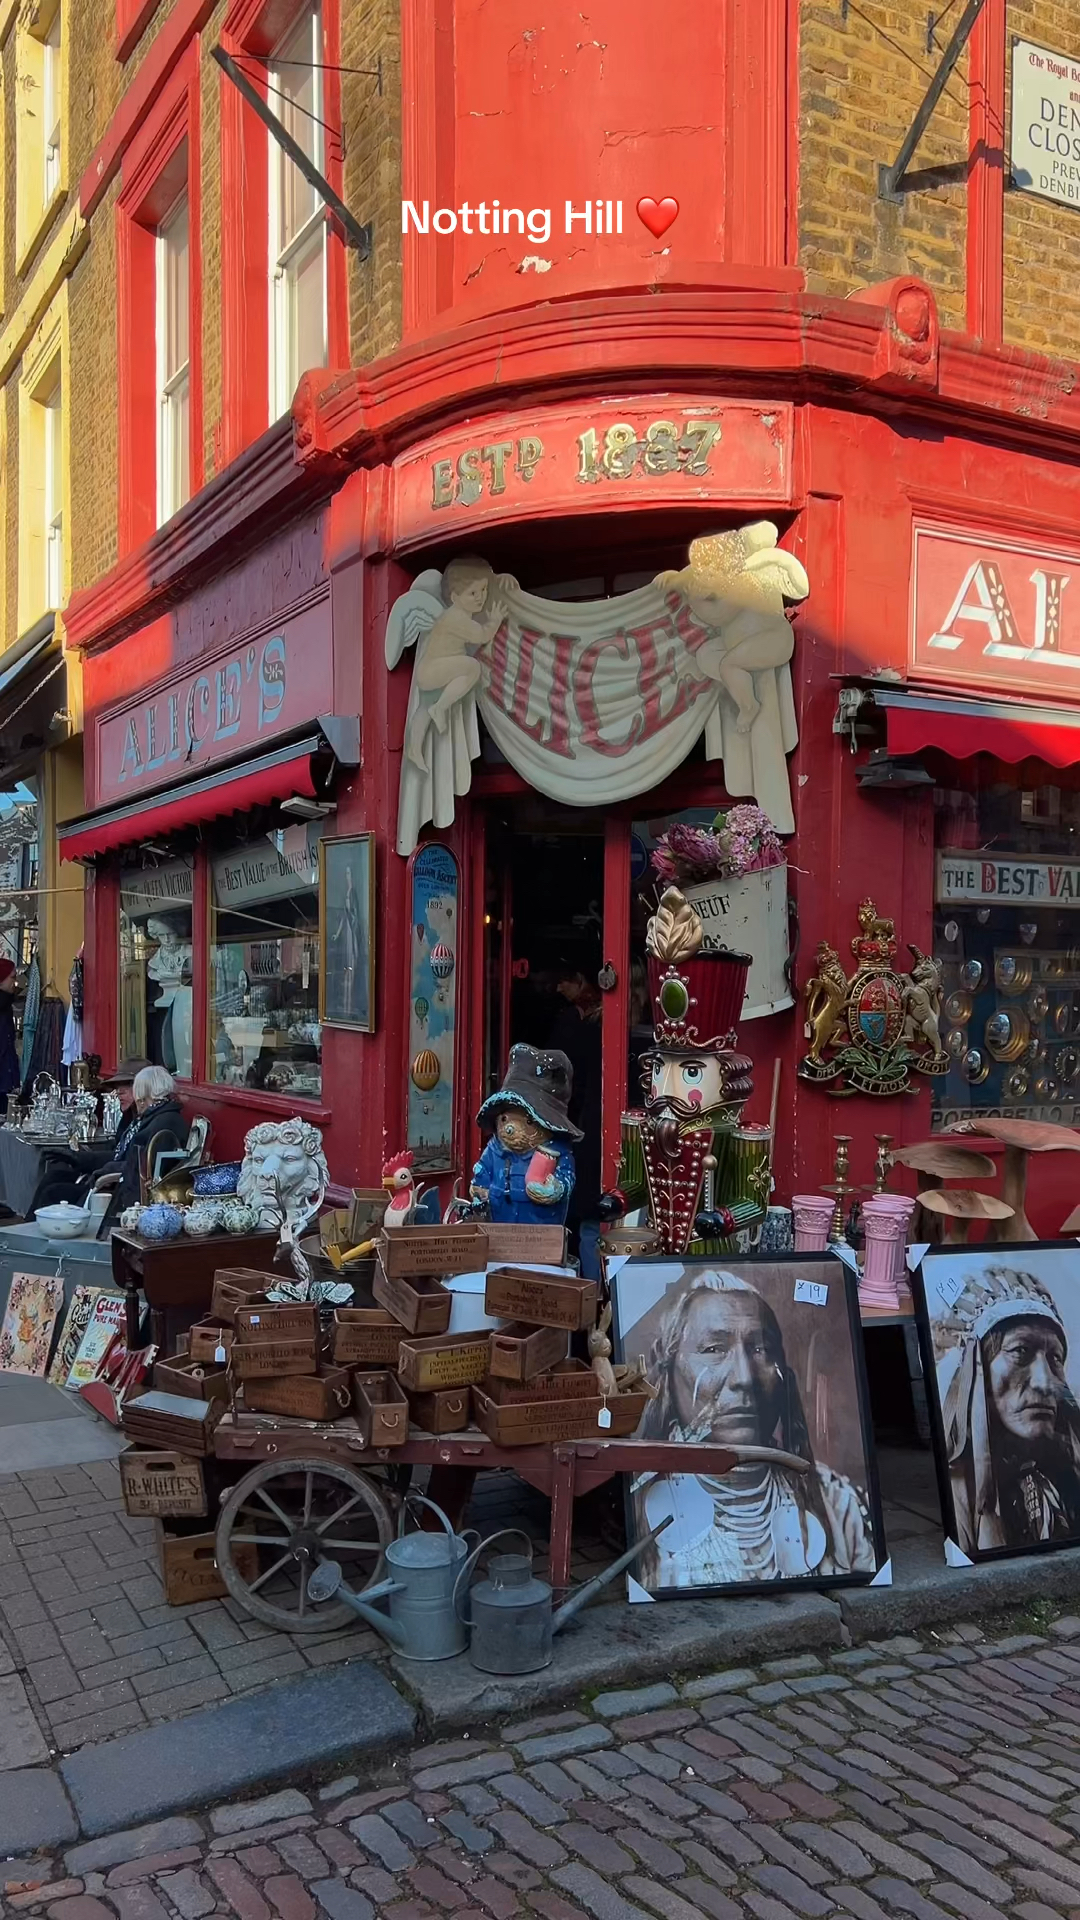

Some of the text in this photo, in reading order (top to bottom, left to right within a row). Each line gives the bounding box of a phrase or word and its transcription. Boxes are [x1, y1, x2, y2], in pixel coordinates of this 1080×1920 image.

[1028, 52, 1044, 68] The
[1046, 58, 1068, 80] Royal
[575, 420, 722, 485] 1887
[117, 628, 286, 783] ALICE'S
[225, 866, 243, 891] BEST
[242, 861, 267, 887] VALUE
[277, 848, 309, 877] BRITISH
[943, 870, 975, 889] THE
[981, 862, 1040, 897] BEST
[426, 901, 443, 909] 1892
[880, 1080, 906, 1091] MON
[96, 1297, 121, 1314] GLEN
